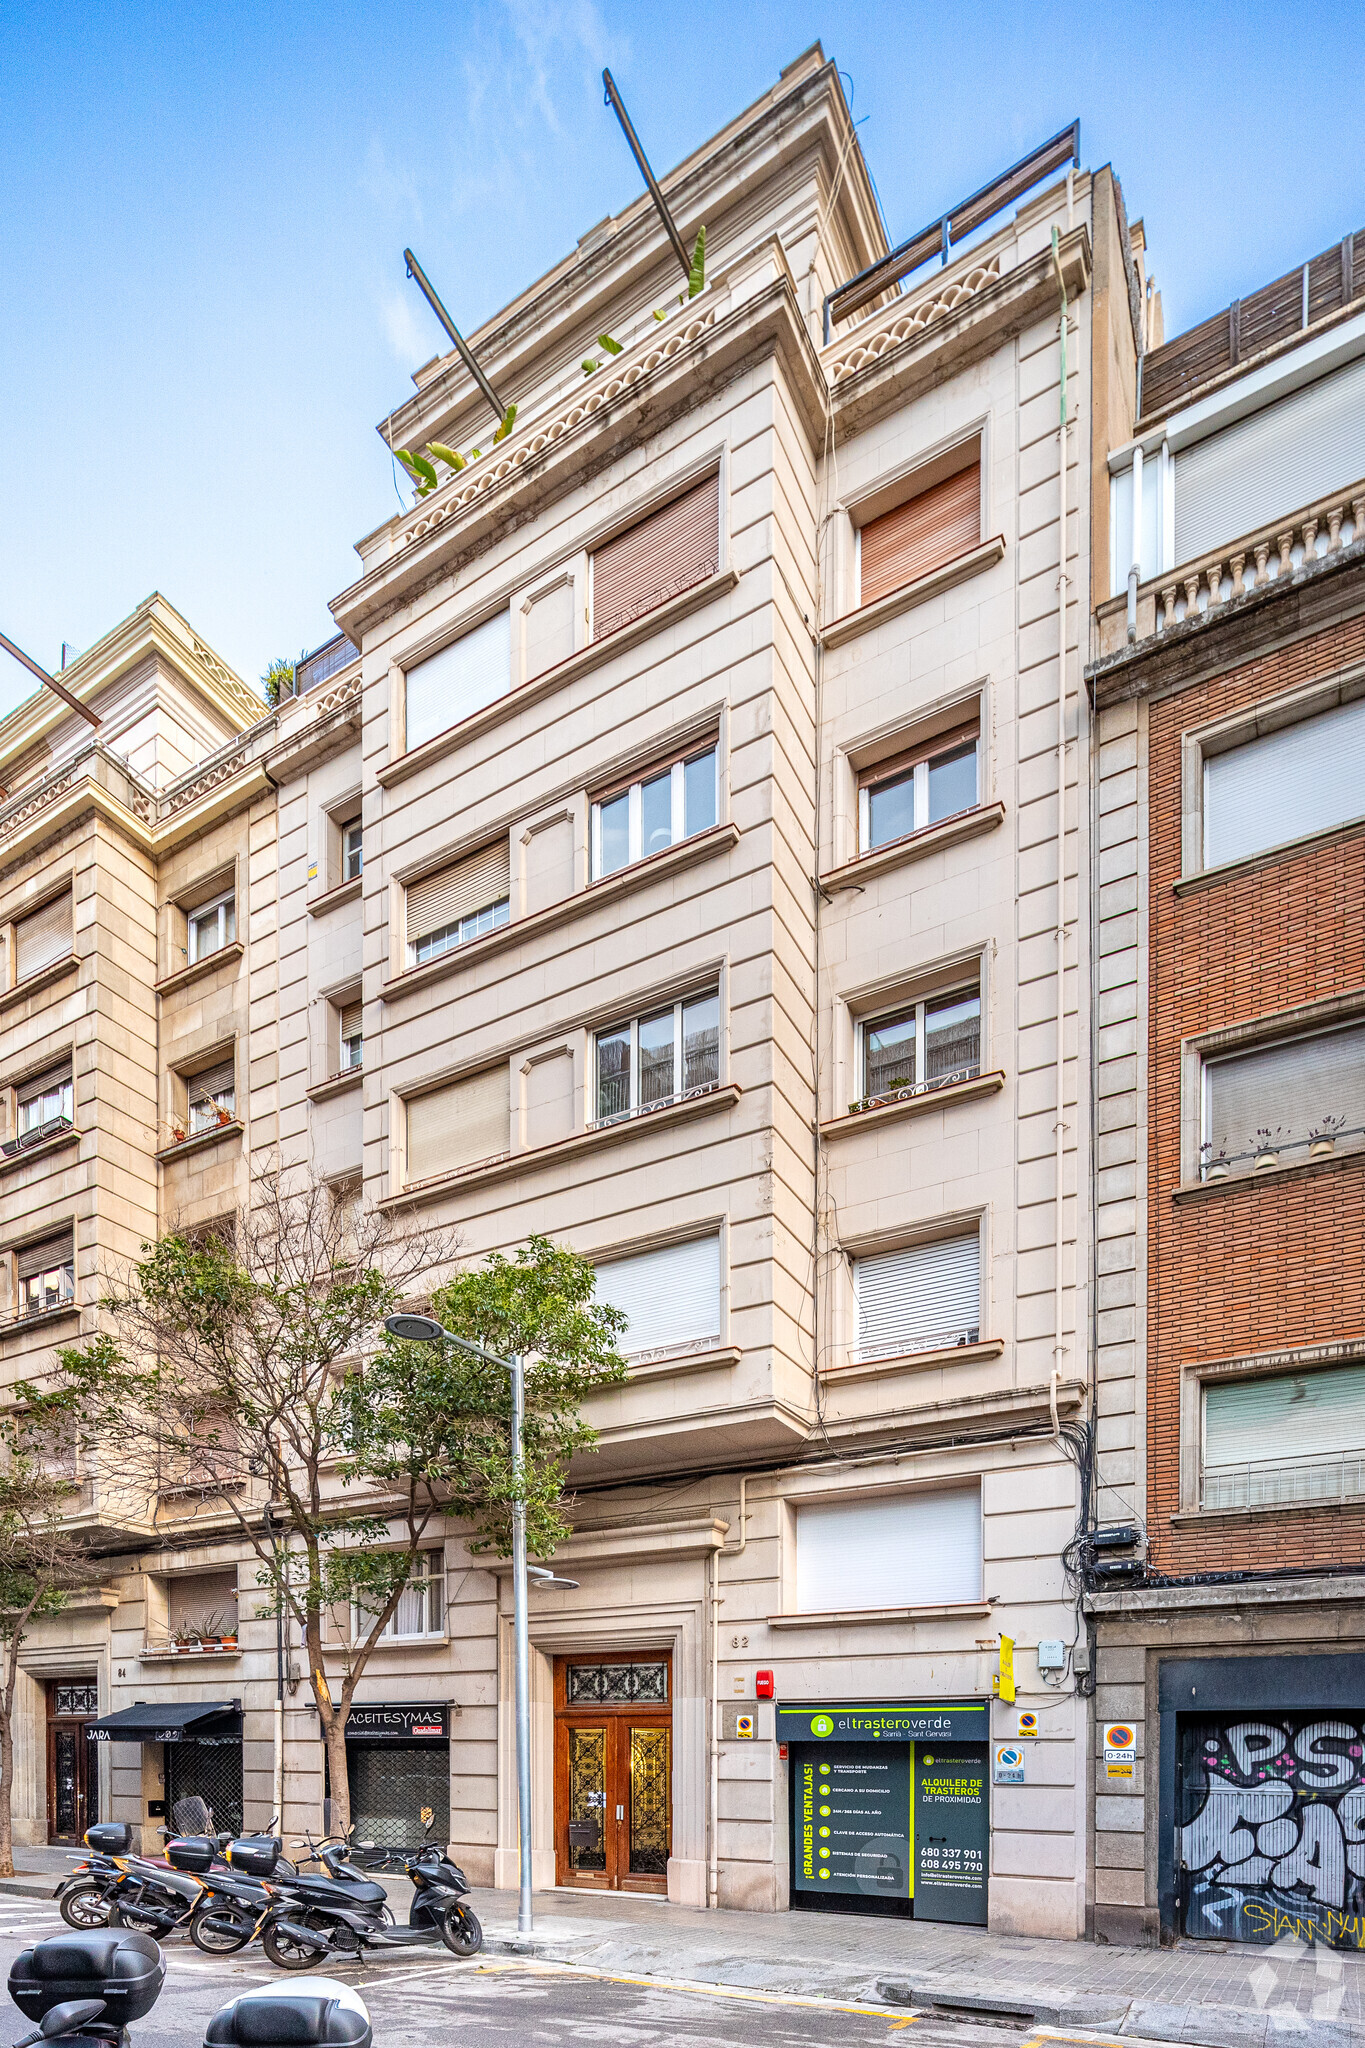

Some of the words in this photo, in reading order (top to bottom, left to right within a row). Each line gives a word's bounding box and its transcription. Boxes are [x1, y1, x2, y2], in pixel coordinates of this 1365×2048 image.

[732, 1636, 749, 1648] 82
[118, 1668, 126, 1678] 84
[347, 1711, 443, 1728] ACEITESYMAS
[86, 1730, 111, 1740] JARA
[908, 1730, 924, 1738] Sant
[925, 1730, 952, 1738] Gervasi
[921, 1778, 968, 1787] ALQUILER
[970, 1779, 983, 1788] DE
[803, 1763, 813, 1822] VENTAJAS!
[924, 1787, 980, 1796] TRASTEROS
[935, 1796, 982, 1804] PROXIMIDAD
[921, 1848, 940, 1857] 680
[942, 1849, 961, 1858] 337
[963, 1850, 982, 1859] 901
[921, 1859, 940, 1868] 608
[942, 1861, 961, 1870] 495
[963, 1862, 983, 1871] 790
